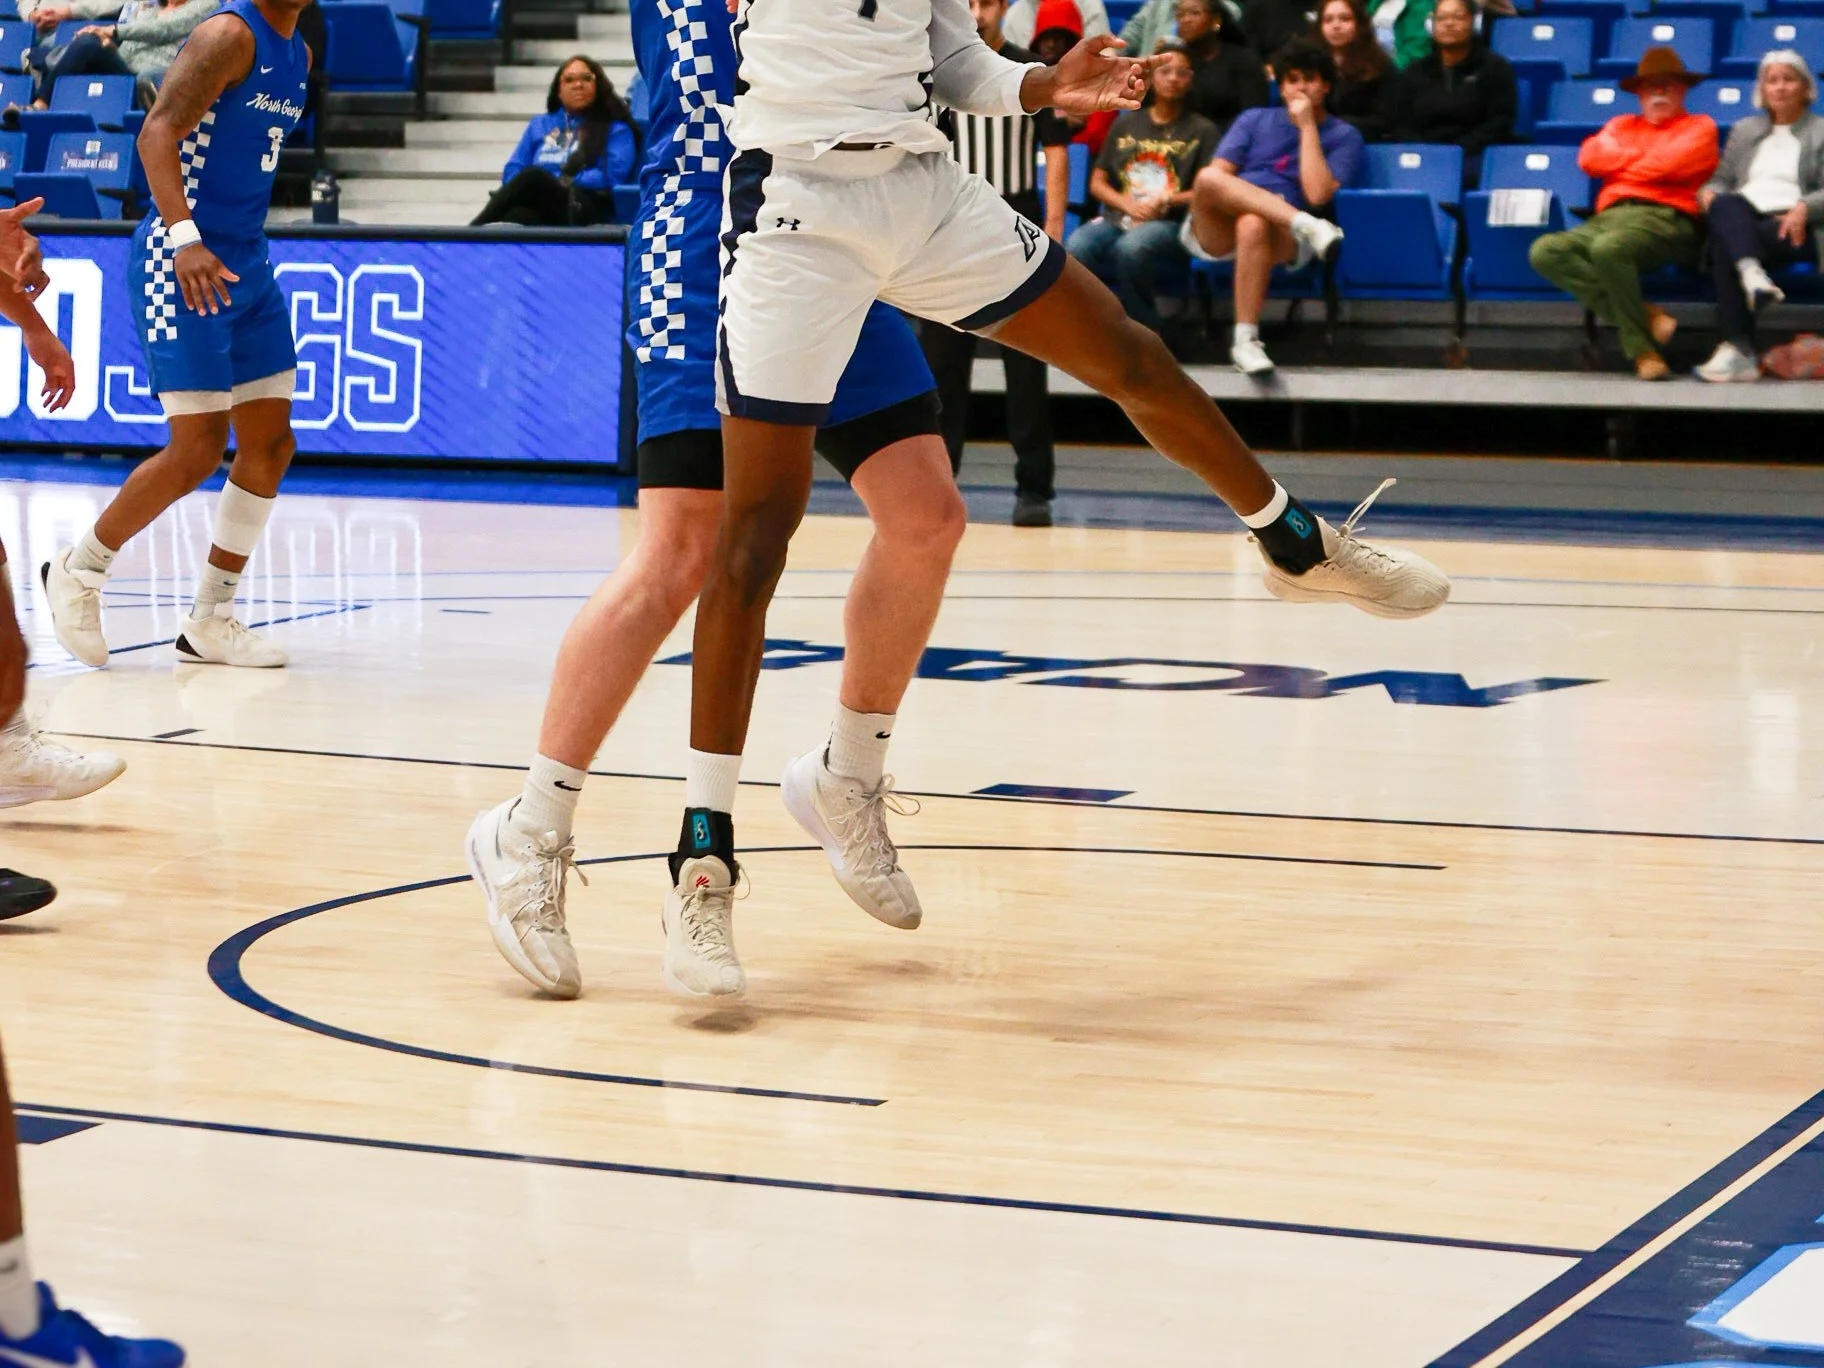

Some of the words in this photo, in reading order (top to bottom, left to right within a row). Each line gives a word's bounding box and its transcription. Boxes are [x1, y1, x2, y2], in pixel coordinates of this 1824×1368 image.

[246, 93, 281, 113] North
[281, 99, 304, 124] Georg
[260, 126, 284, 173] 3
